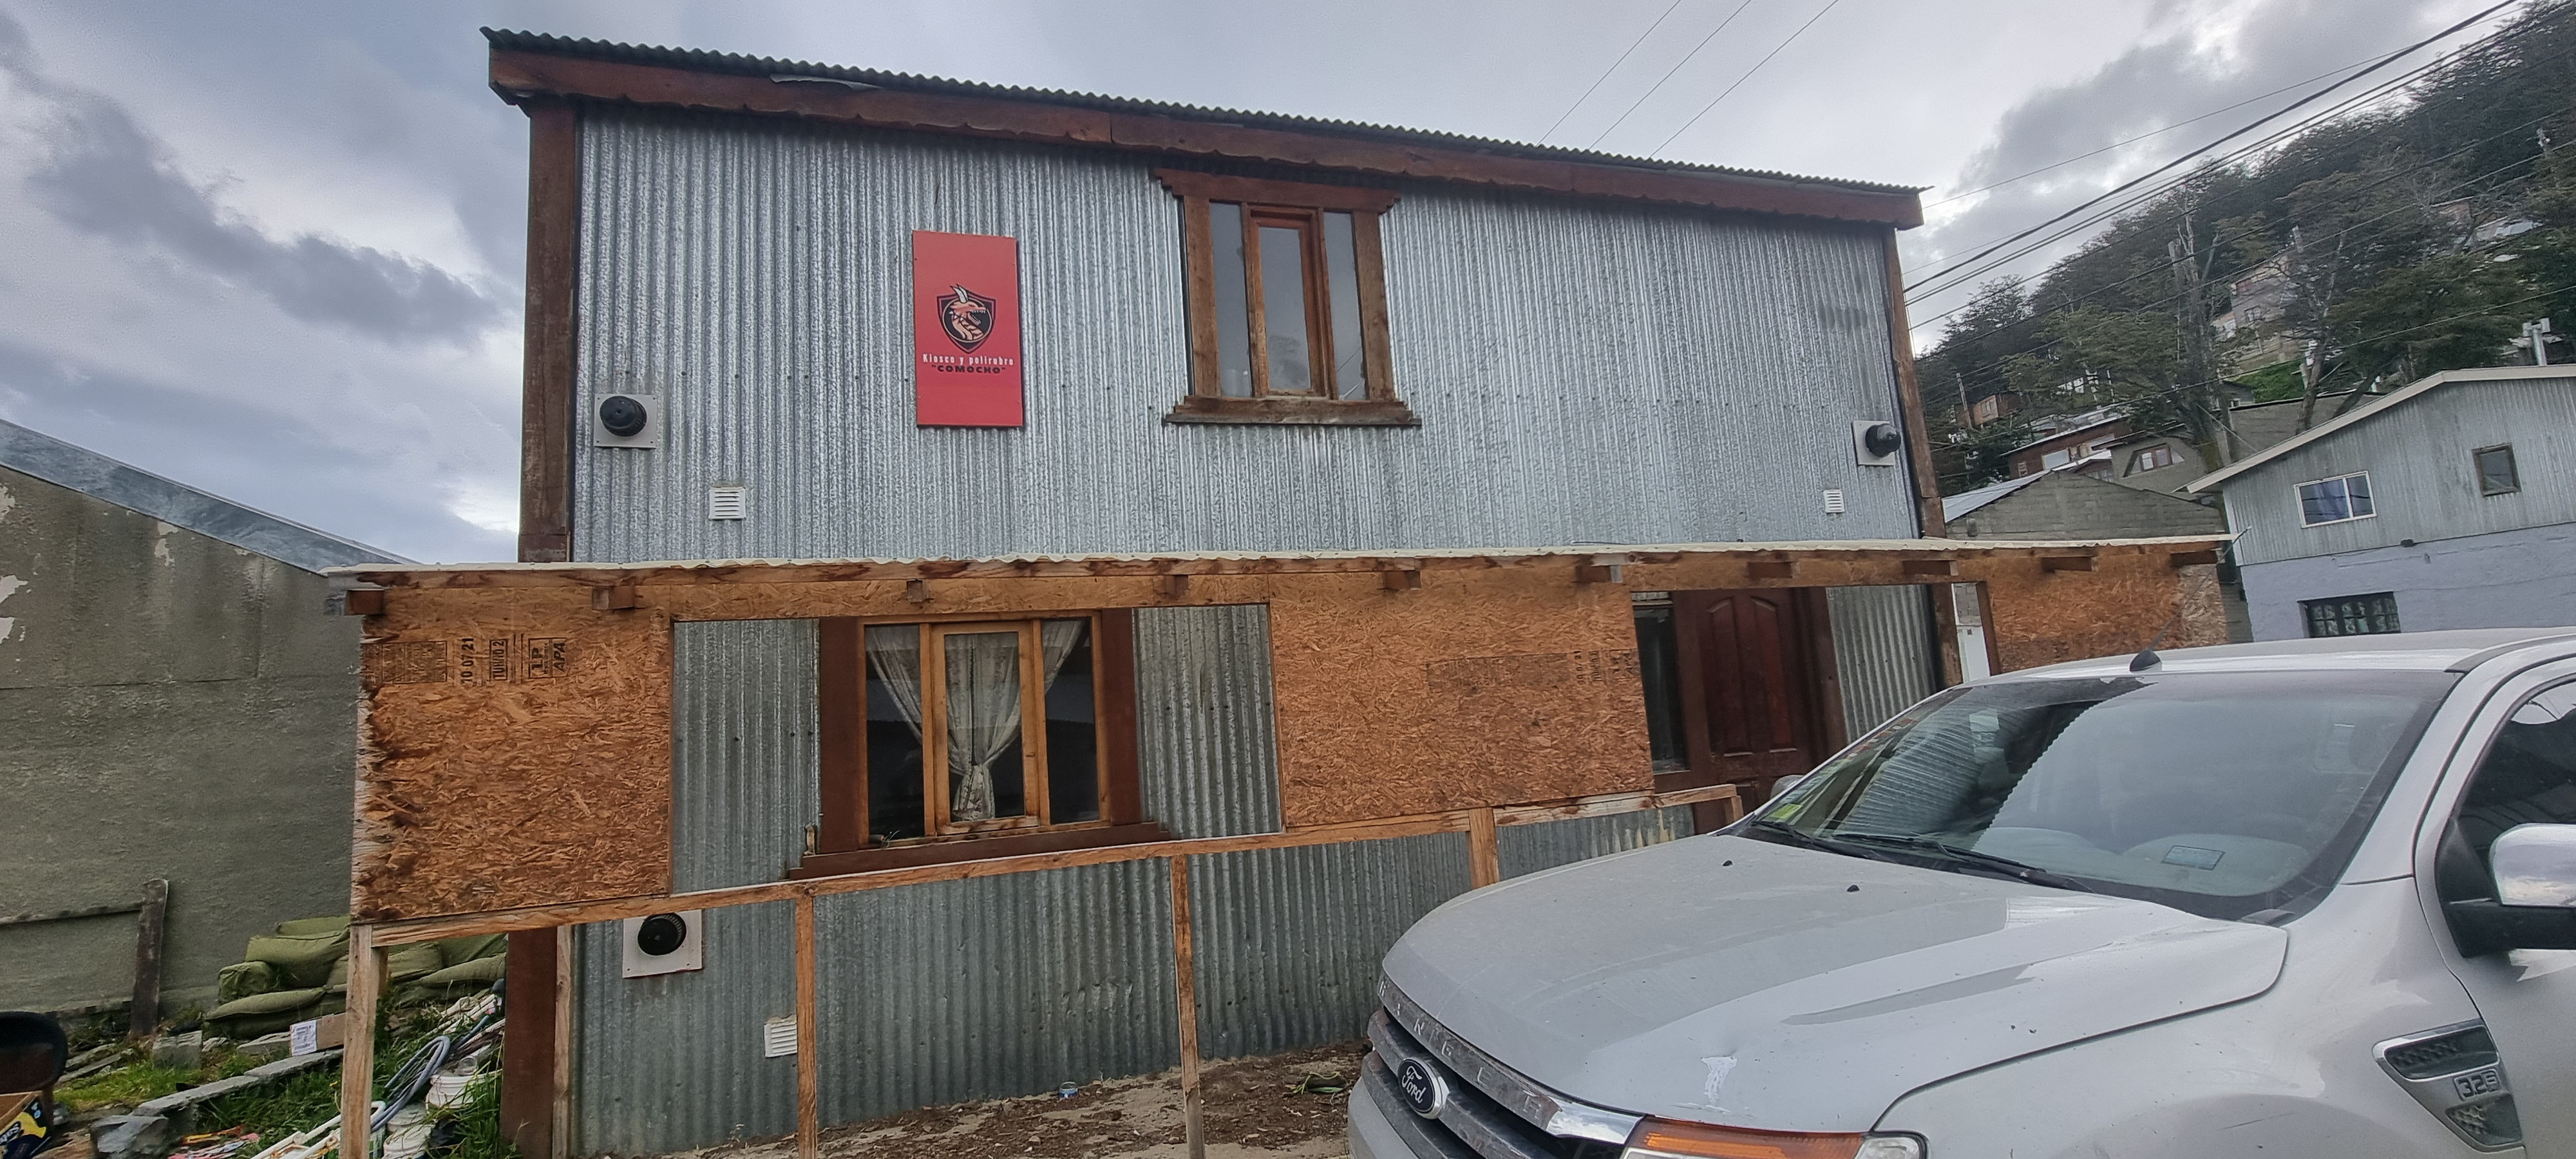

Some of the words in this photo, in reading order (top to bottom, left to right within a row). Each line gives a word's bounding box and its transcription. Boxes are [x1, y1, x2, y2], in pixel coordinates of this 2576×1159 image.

[923, 353, 955, 364] Kiosco
[960, 356, 964, 365] y
[969, 355, 1014, 366] polirubro
[461, 638, 474, 650] 21
[531, 648, 543, 670] LP
[553, 643, 565, 672] APA
[1402, 1066, 1426, 1104] Ford
